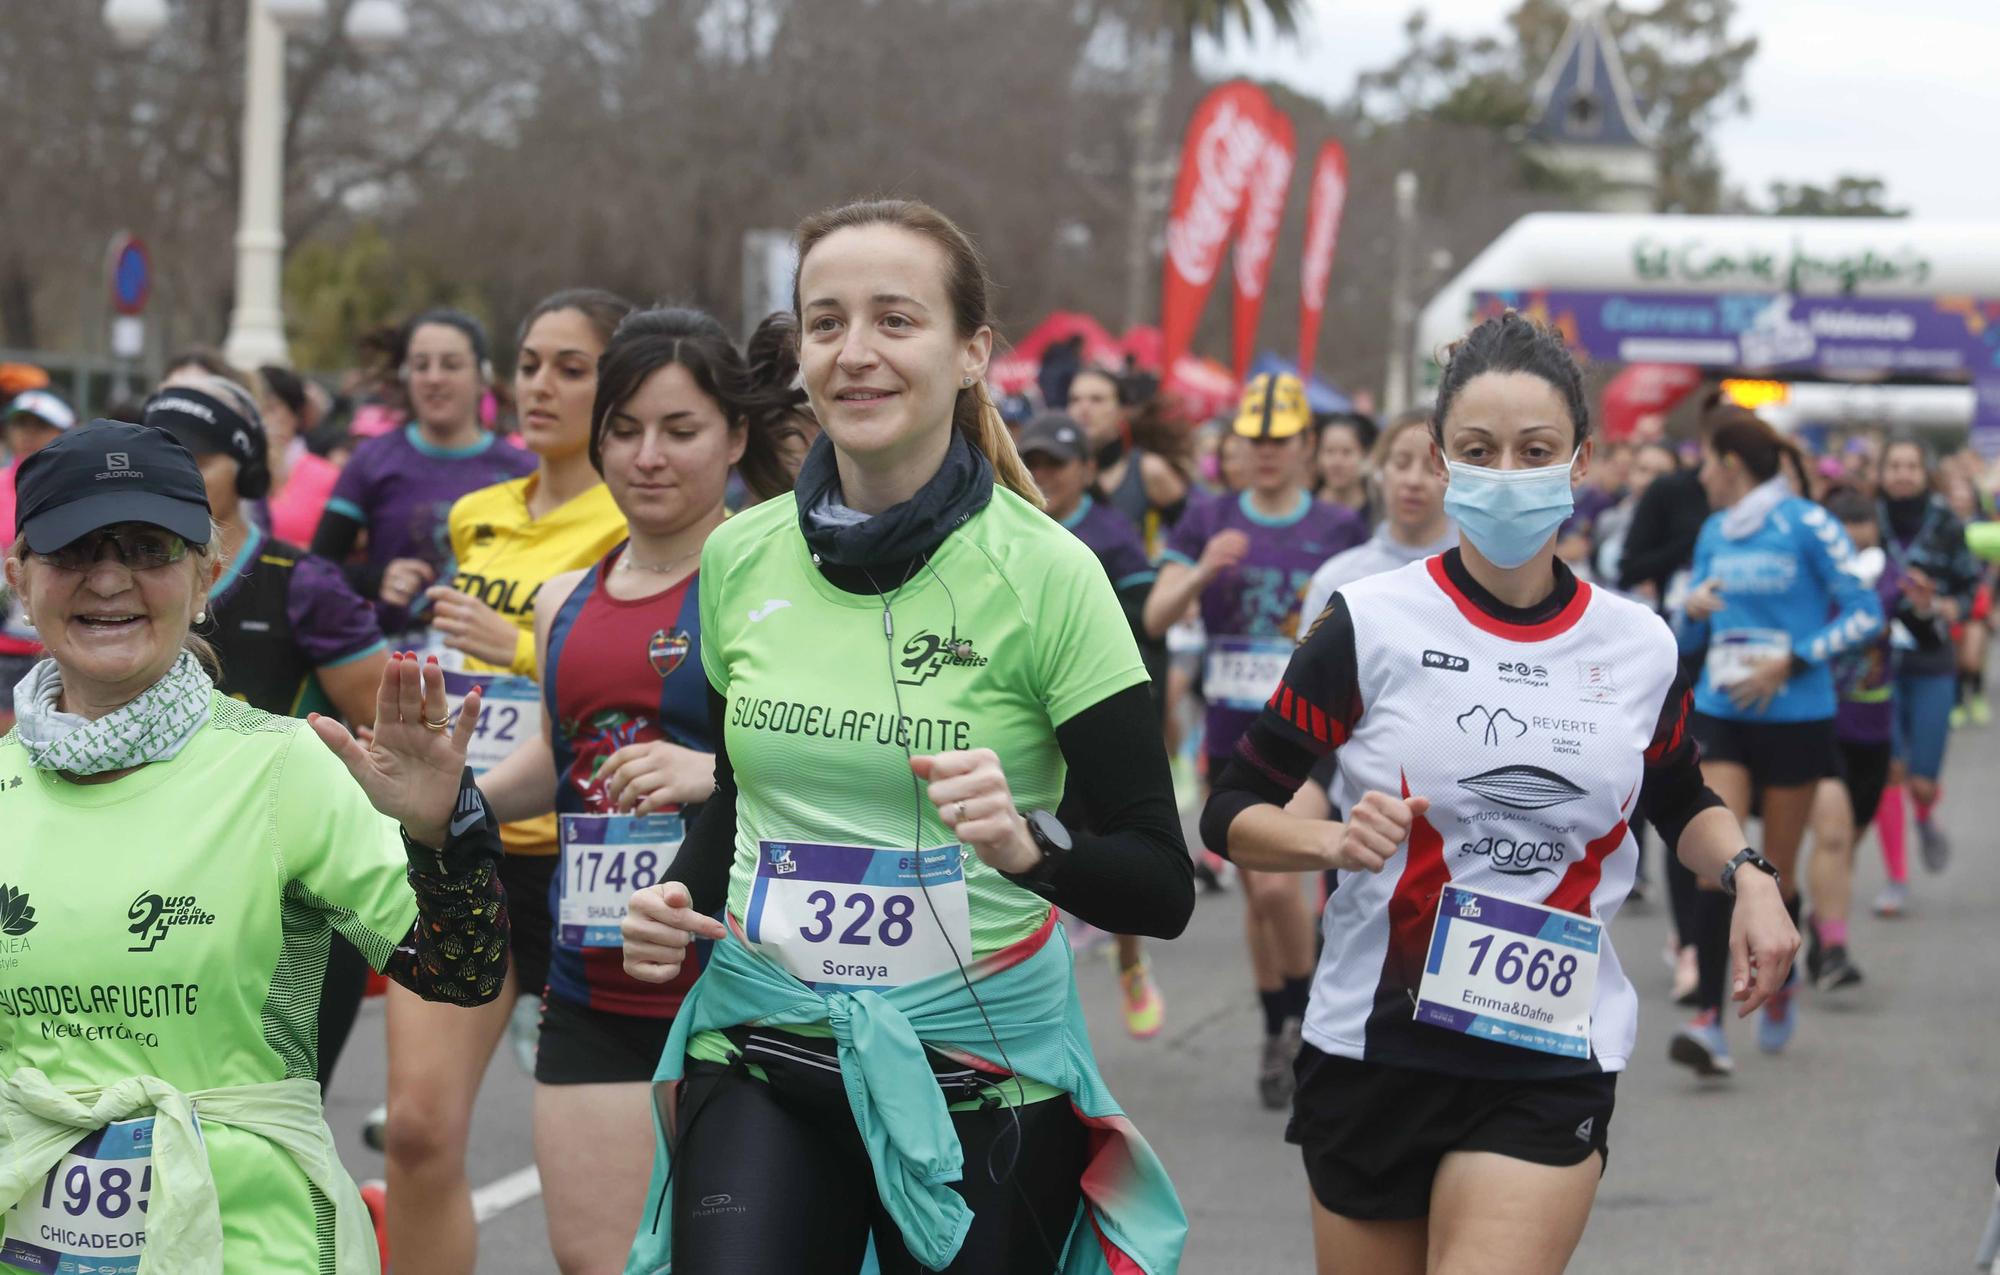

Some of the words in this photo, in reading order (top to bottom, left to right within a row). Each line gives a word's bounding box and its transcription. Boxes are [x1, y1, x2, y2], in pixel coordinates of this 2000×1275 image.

[732, 696, 970, 752] SUSODELAFUENTE
[1533, 716, 1597, 734] REVERTE
[575, 850, 658, 893] 1748
[799, 889, 915, 947] 328
[823, 960, 888, 980] Soraya
[1468, 934, 1578, 998] 1668
[1462, 989, 1554, 1024] Emma&Dafne
